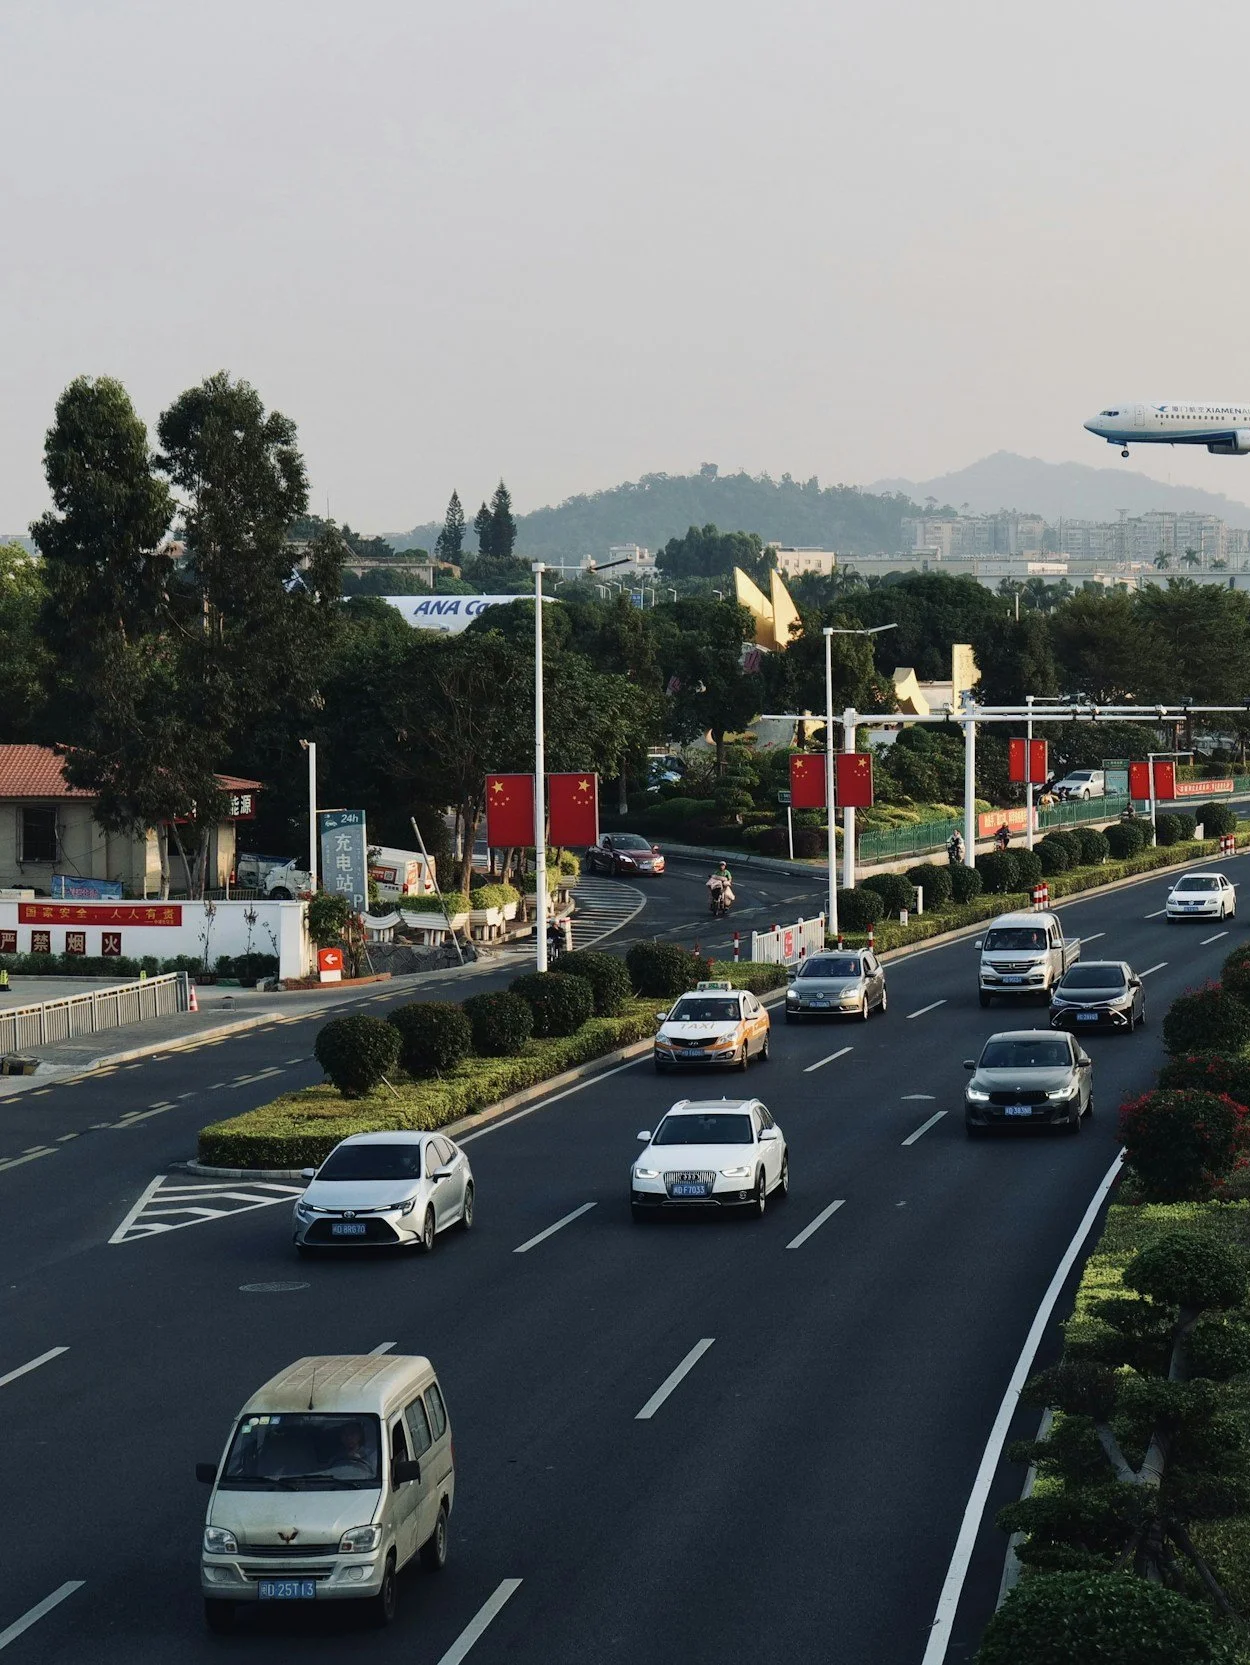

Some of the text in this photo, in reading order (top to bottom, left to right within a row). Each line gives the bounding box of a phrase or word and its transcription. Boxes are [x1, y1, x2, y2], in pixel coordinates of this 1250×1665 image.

[413, 600, 461, 615] ANA
[340, 813, 359, 824] 24h
[334, 833, 354, 893] 充电站
[0, 932, 119, 952] 严禁烟火
[680, 1022, 717, 1030] TAXI
